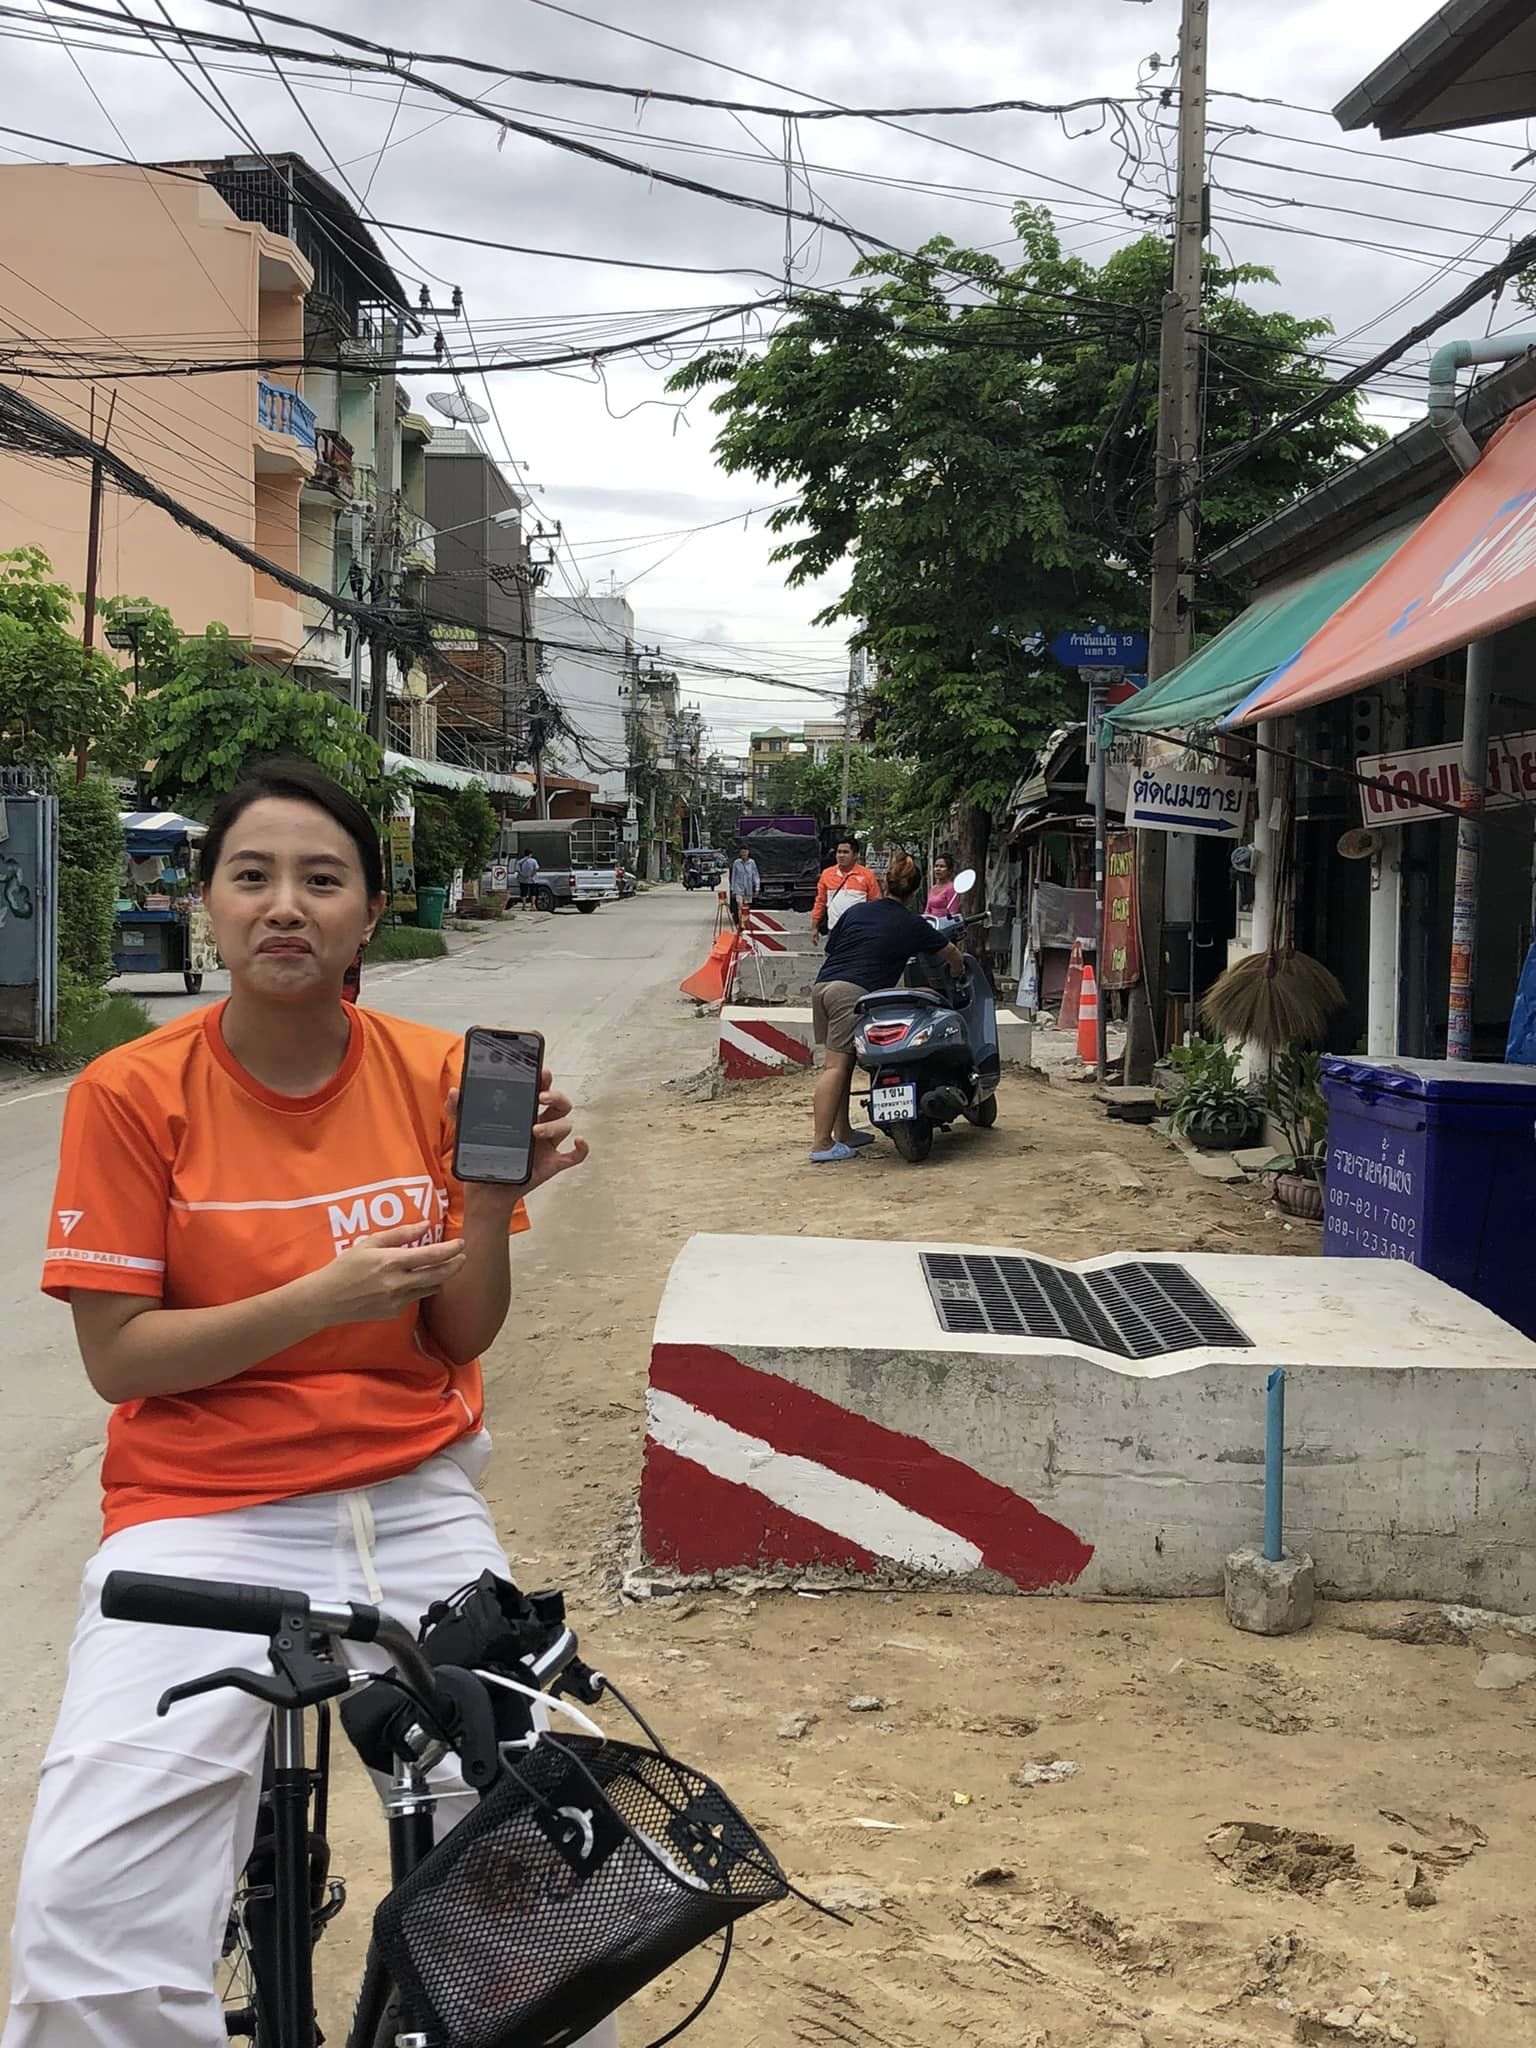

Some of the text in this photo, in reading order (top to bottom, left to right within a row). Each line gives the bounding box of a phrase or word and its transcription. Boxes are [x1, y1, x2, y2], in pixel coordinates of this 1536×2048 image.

[1122, 635, 1133, 647] 13
[1084, 647, 1117, 656] แยก 13
[1133, 771, 1243, 813] ตัดผมชาย
[878, 1109, 909, 1121] 4190
[93, 1252, 130, 1266] PARTY
